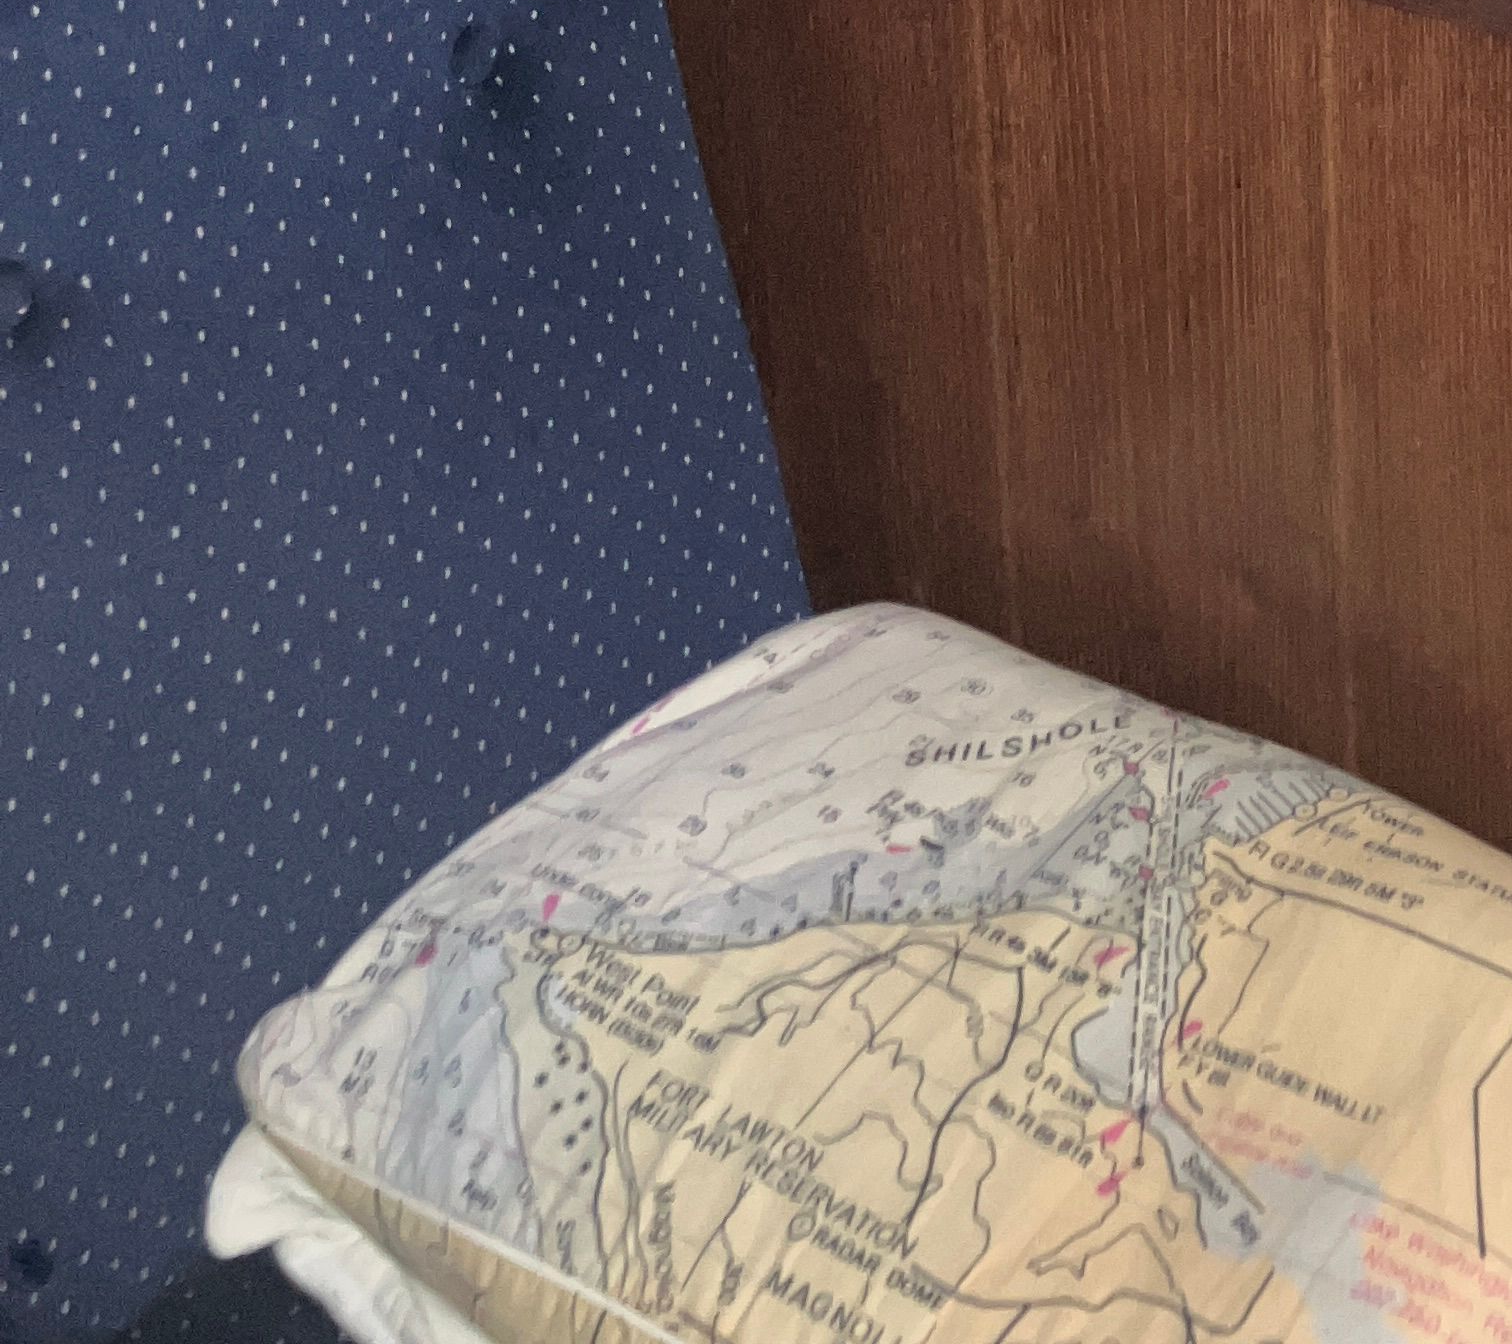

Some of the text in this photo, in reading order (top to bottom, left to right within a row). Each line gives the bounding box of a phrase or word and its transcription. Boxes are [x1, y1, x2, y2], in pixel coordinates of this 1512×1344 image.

[646, 1069, 825, 1173] FORT LAWTON
[745, 1146, 919, 1260] RESERVATION
[810, 1225, 882, 1274] RADAR
